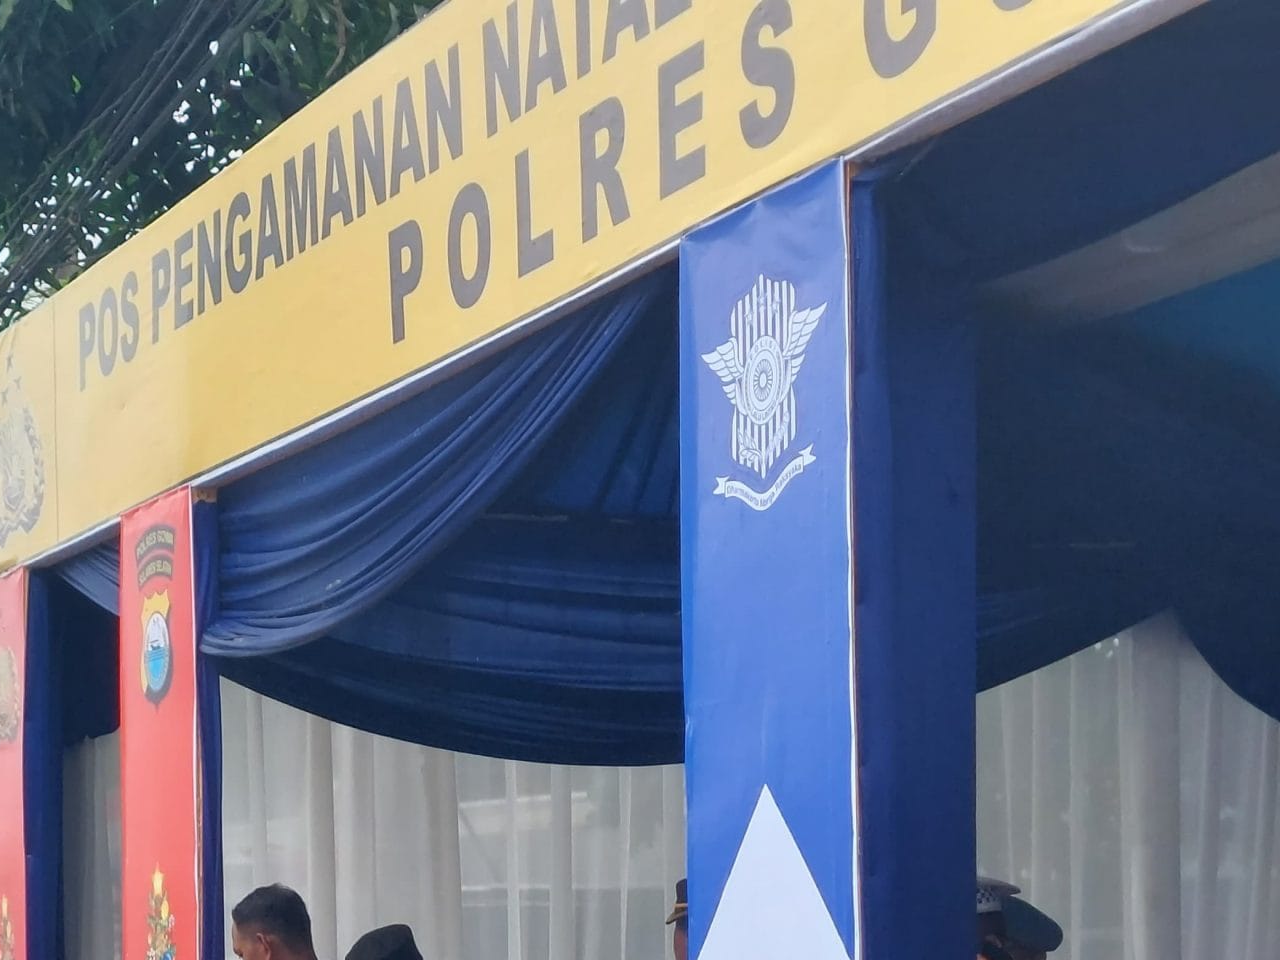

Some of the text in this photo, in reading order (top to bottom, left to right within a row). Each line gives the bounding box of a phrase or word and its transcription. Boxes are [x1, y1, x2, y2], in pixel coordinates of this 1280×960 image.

[79, 271, 139, 393] POS
[152, 42, 463, 345] PENGAMANAN
[389, 0, 795, 345] POLRES
